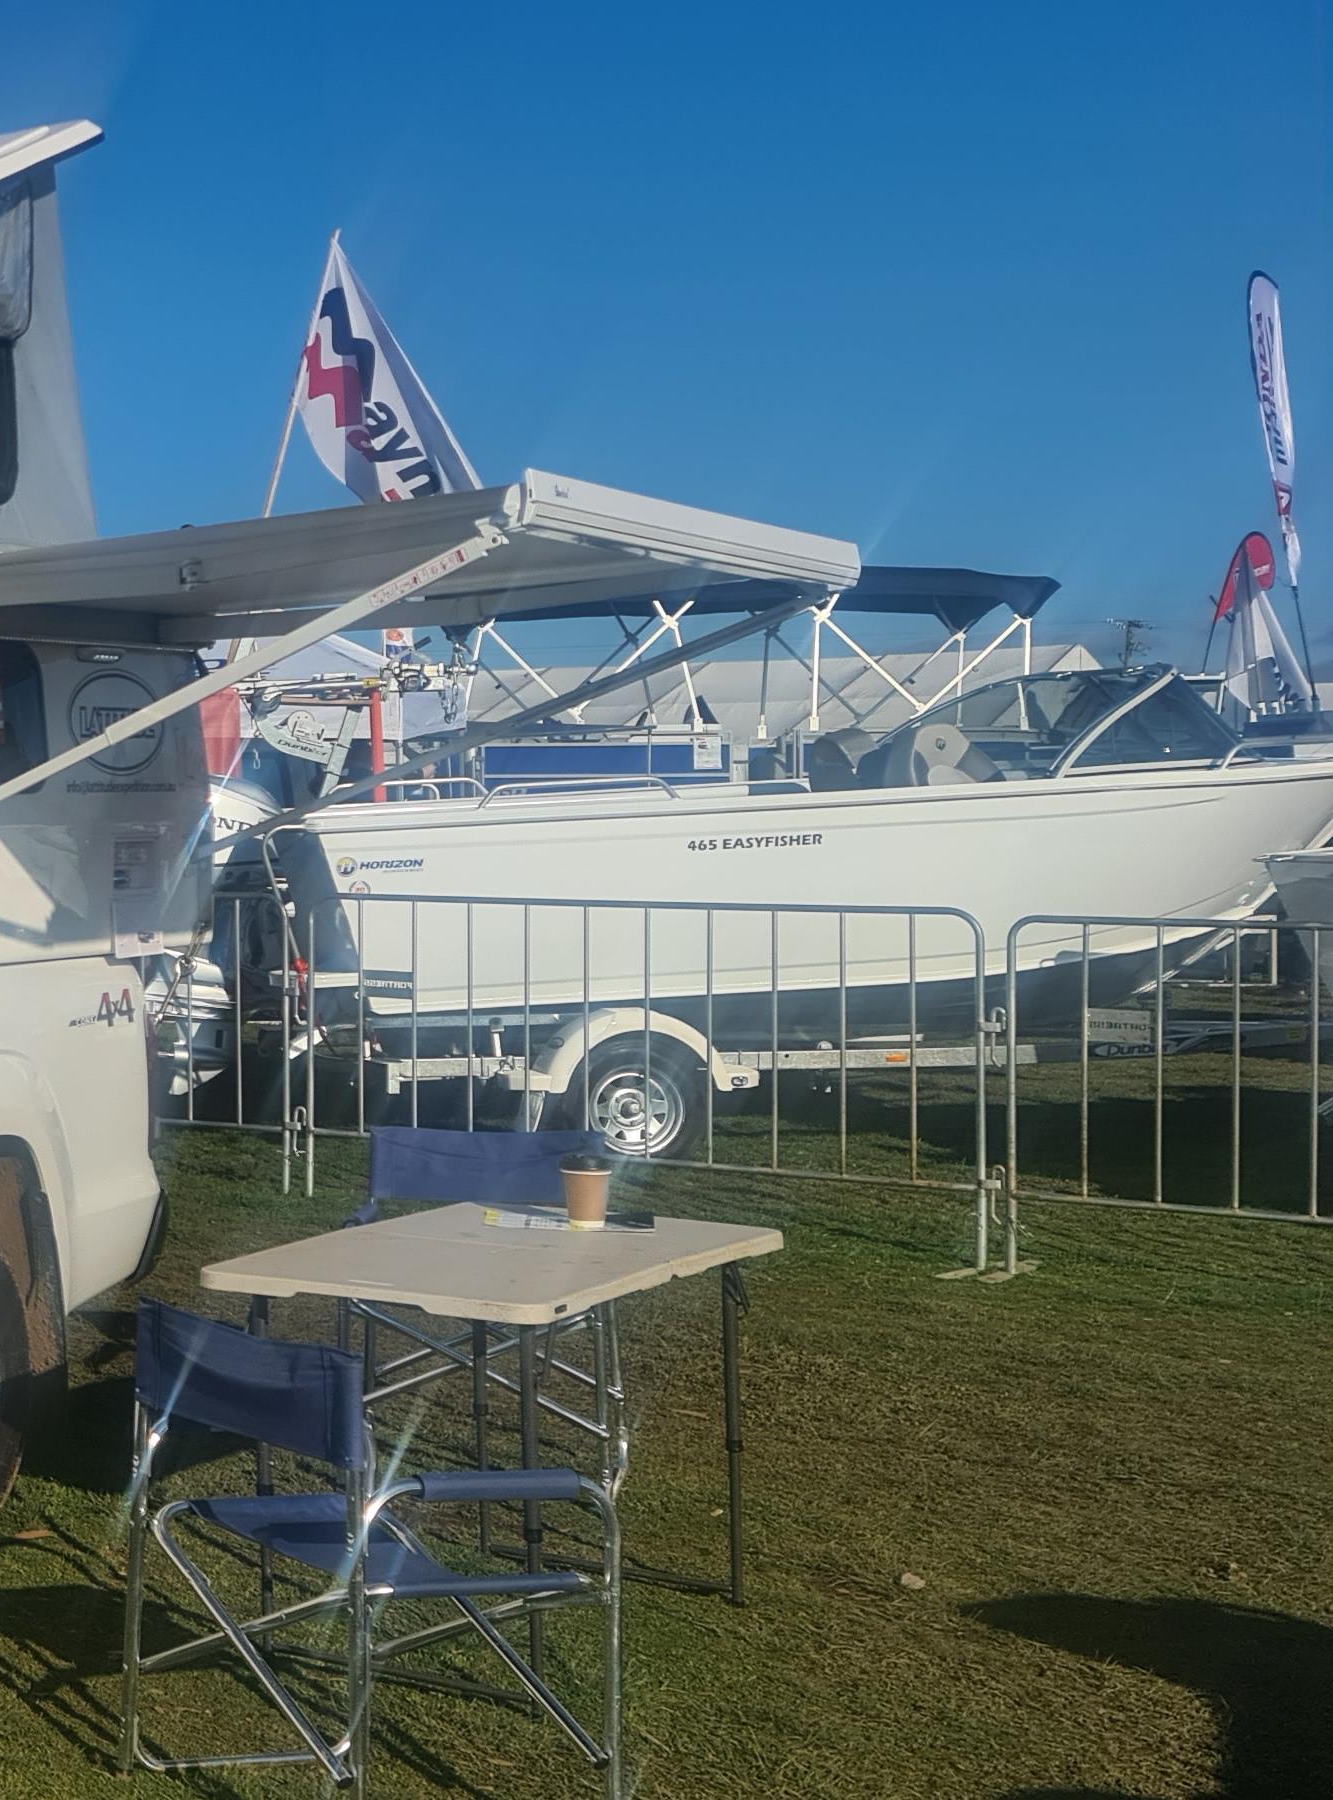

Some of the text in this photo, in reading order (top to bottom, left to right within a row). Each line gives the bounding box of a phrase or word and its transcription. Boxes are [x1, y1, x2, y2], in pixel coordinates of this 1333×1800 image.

[687, 833, 823, 851] 465 EASYFISHER
[359, 859, 424, 870] HORIZON
